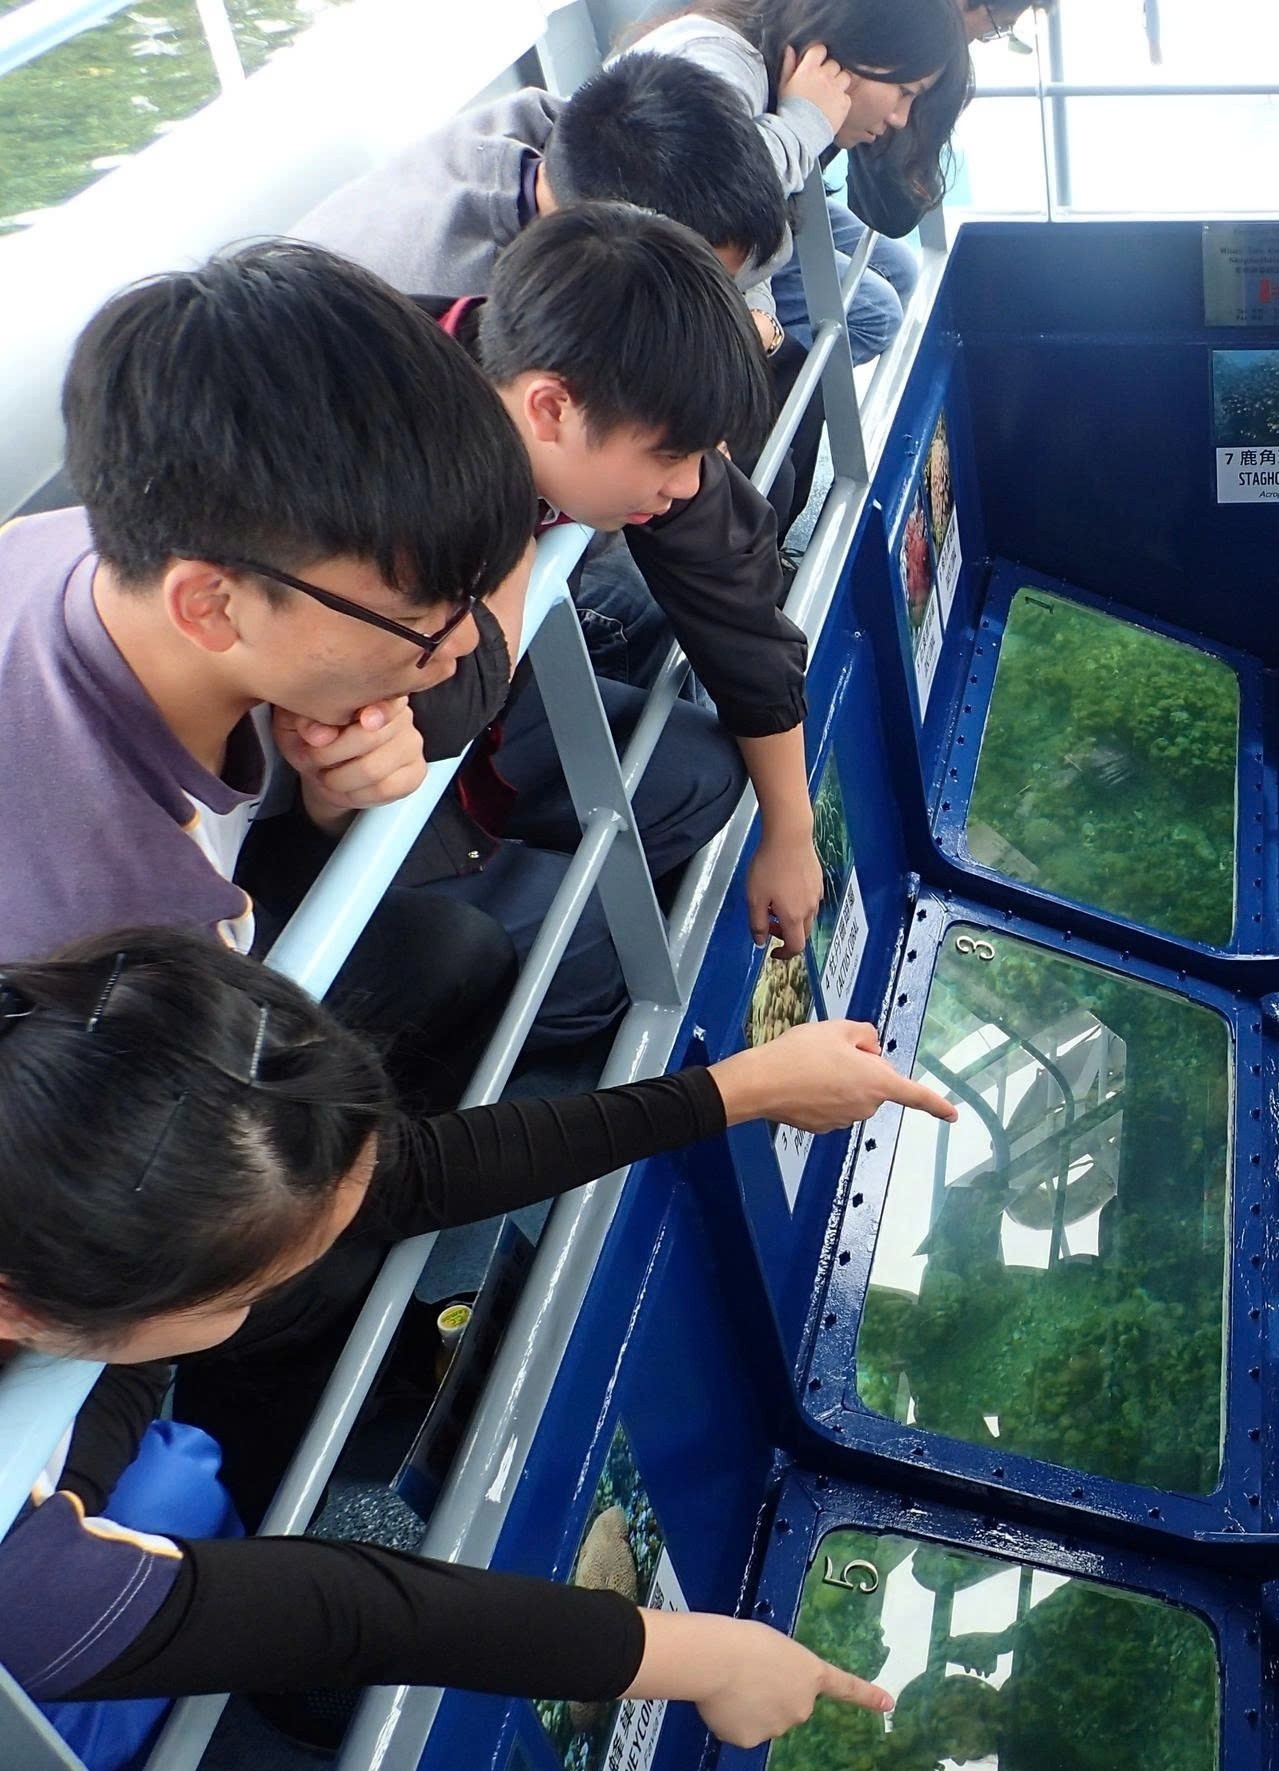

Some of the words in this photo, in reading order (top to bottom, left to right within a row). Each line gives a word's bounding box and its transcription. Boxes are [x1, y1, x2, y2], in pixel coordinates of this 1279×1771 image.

[1225, 453, 1233, 465] 7
[846, 915, 859, 957] CORAL
[956, 935, 995, 960] 3
[782, 1131, 788, 1151] 3
[822, 1556, 879, 1594] 5
